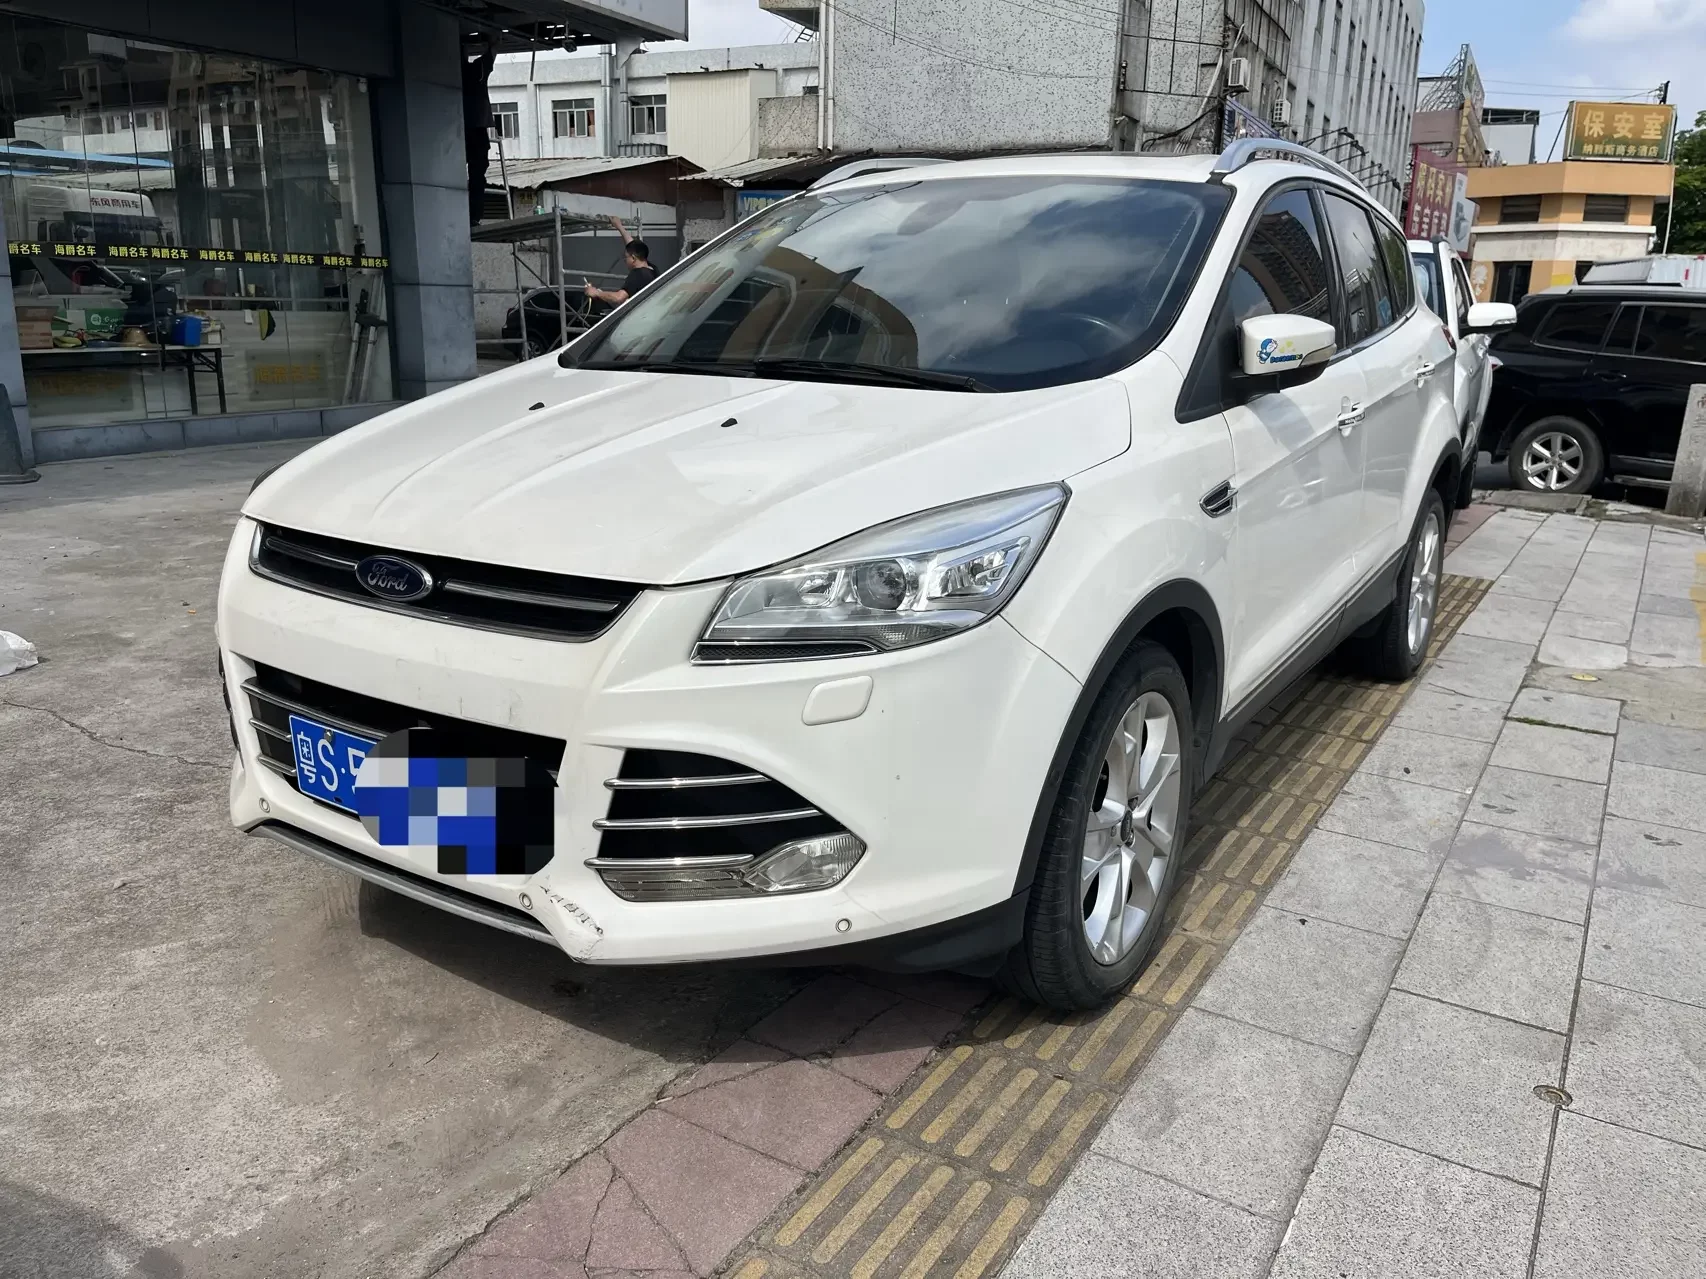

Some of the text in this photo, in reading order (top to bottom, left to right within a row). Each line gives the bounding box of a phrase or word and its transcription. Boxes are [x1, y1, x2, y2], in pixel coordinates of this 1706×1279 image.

[1583, 110, 1664, 139] 保安室
[90, 197, 140, 209] 东风商用车
[54, 244, 96, 256] 海爵名车
[109, 246, 149, 258] 海爵名车
[151, 247, 189, 260] 海爵名车
[199, 250, 235, 261] 海爵名车
[244, 252, 278, 263] 海爵名车
[282, 253, 314, 265] 海爵名车
[322, 256, 353, 266] 海爵名车
[360, 257, 389, 268] 海爵名车
[367, 563, 408, 592] Ford
